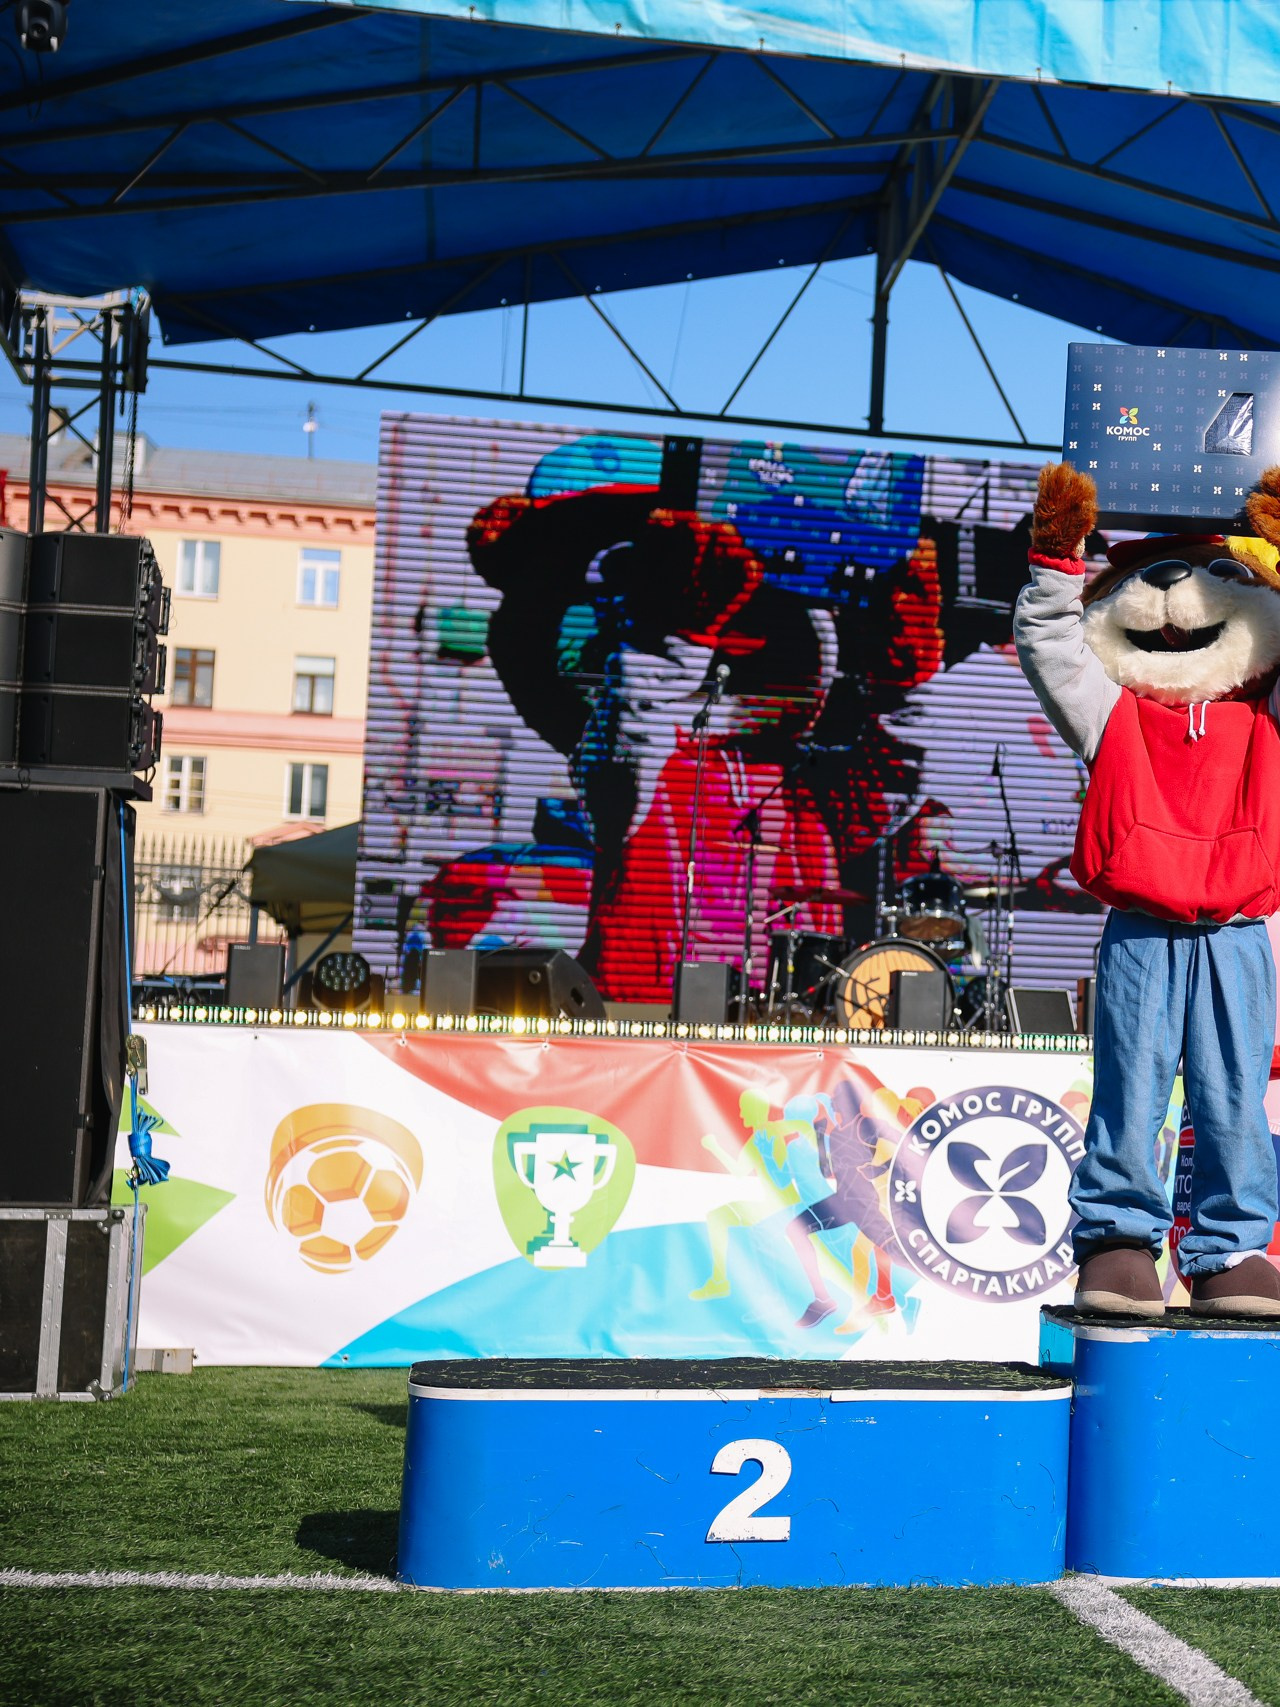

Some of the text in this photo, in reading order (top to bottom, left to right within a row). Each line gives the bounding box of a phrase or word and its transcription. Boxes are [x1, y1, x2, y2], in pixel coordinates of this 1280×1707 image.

[1106, 426, 1150, 436] КОМОС
[907, 1091, 1088, 1162] КОМОС ГРУПП
[908, 1227, 1075, 1297] СПАРТАКИАД
[706, 1438, 792, 1543] 2
